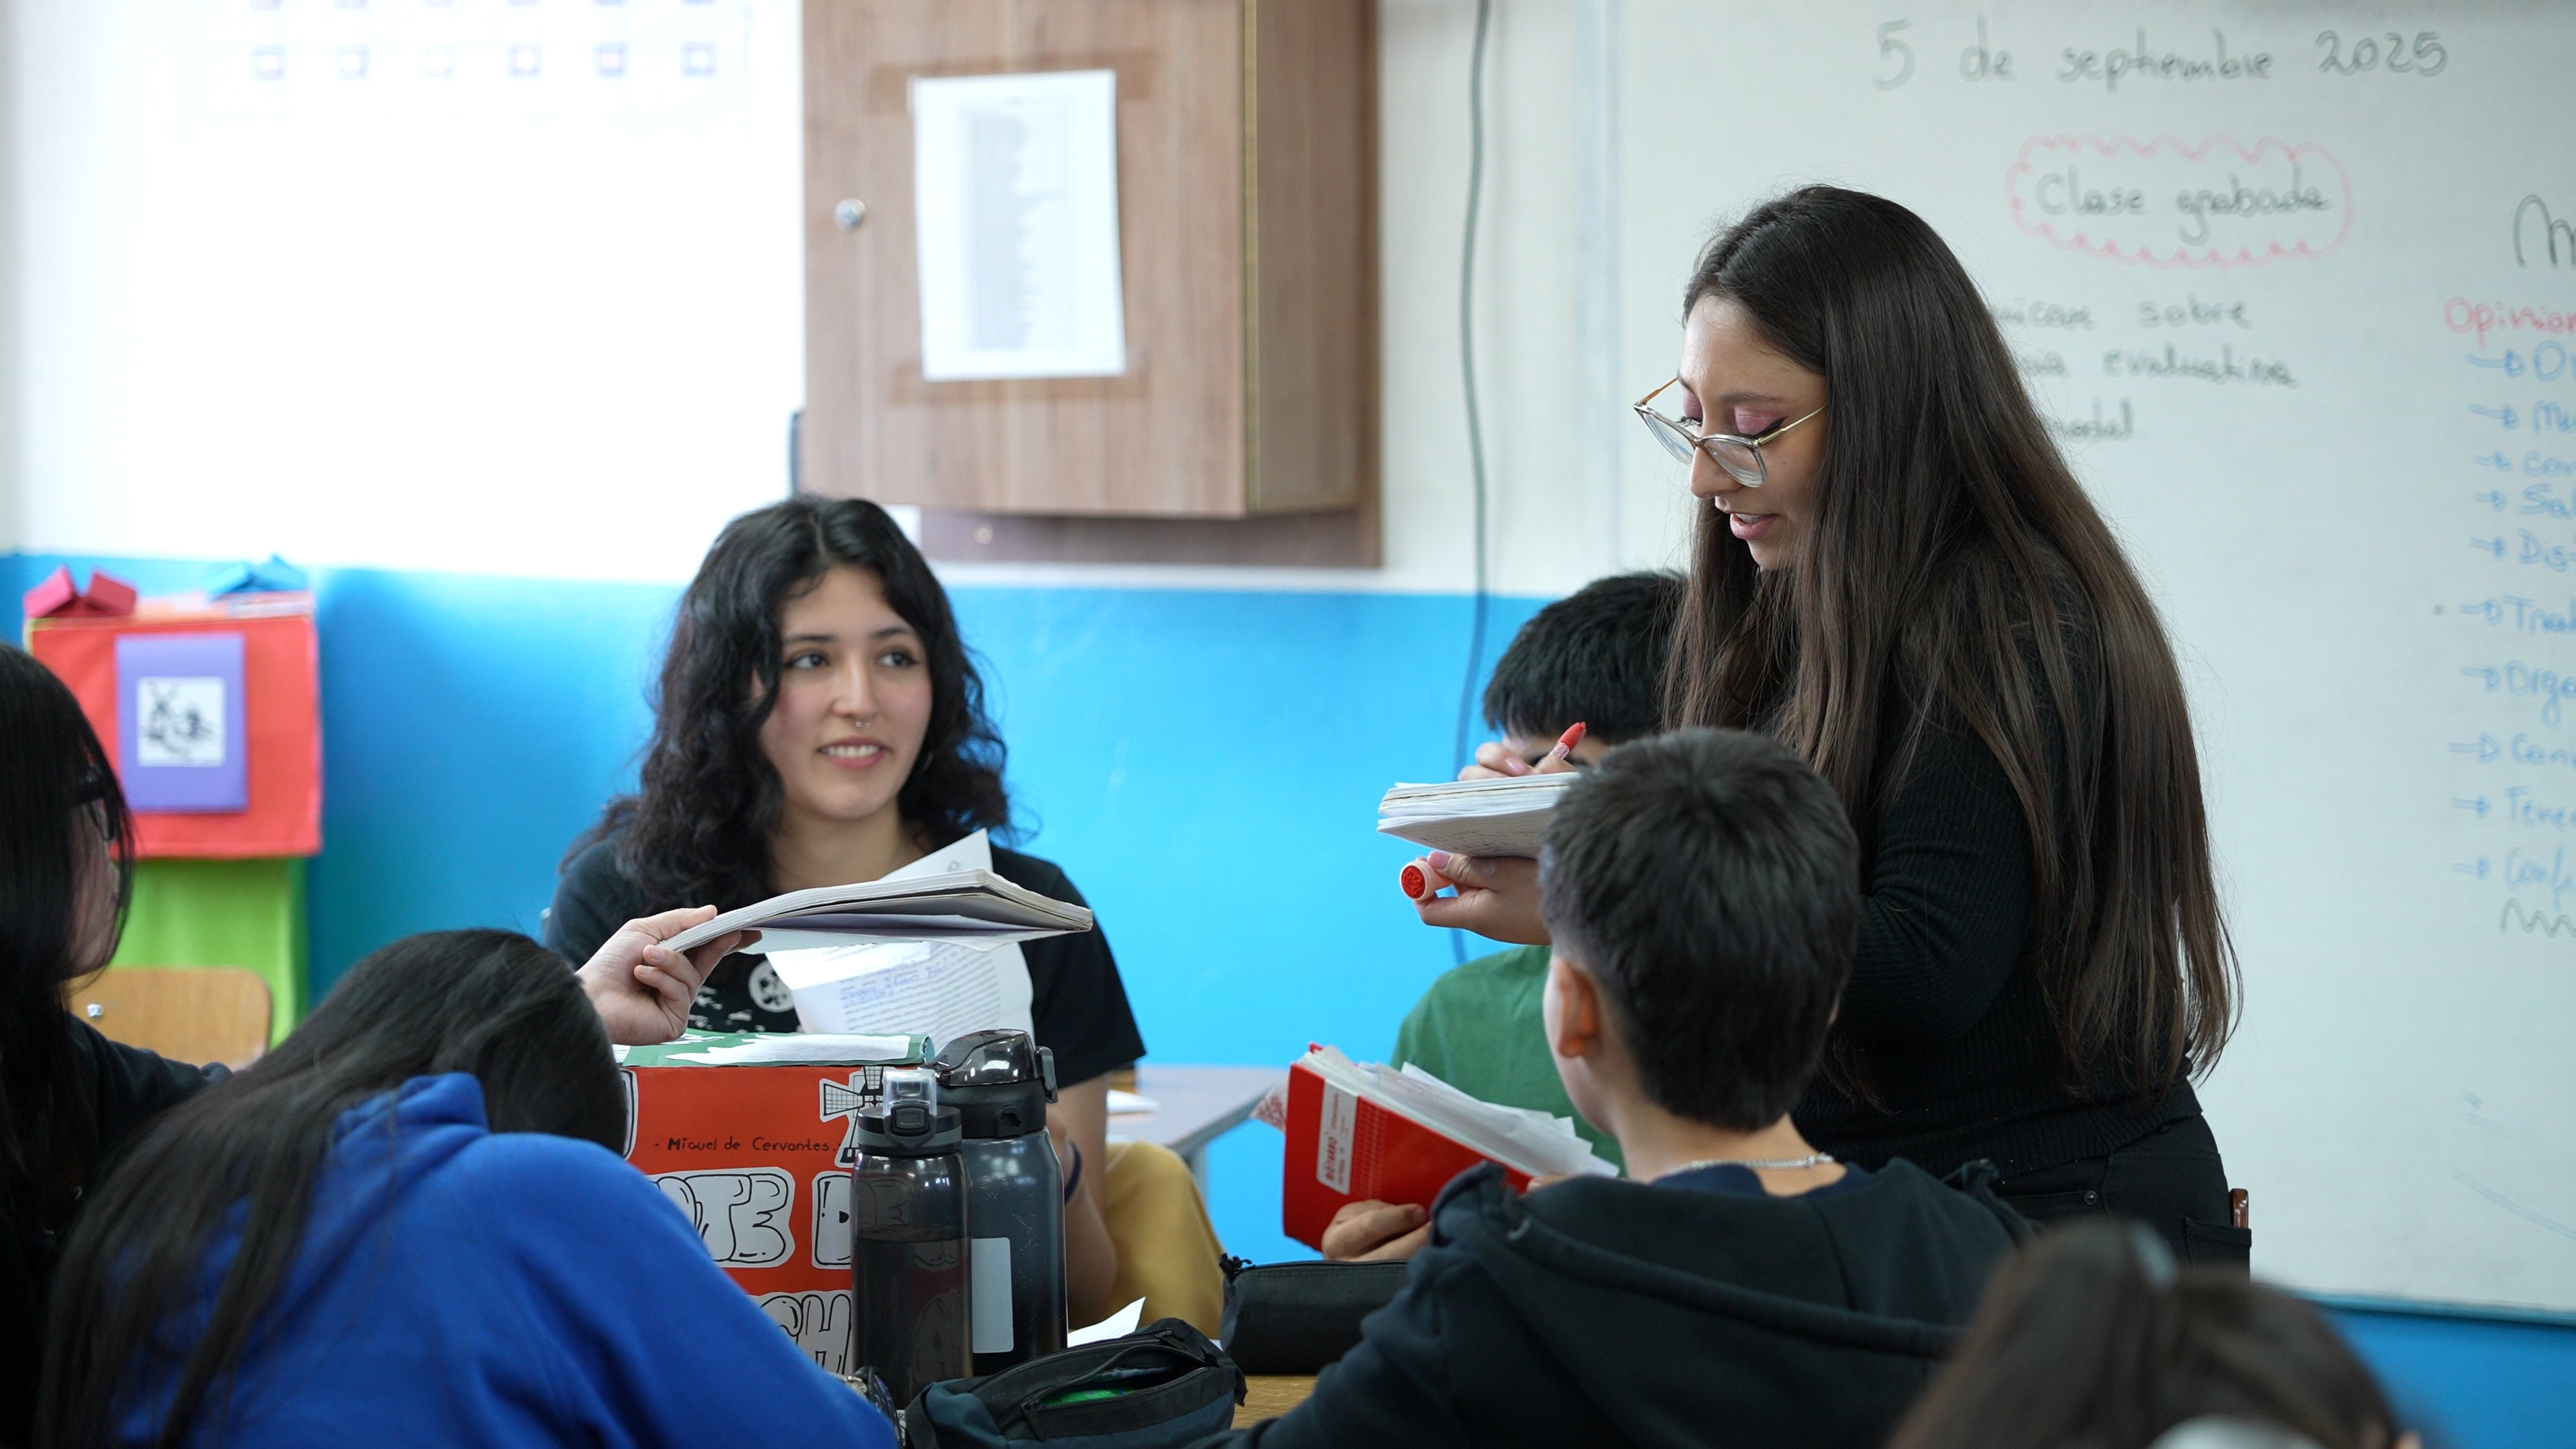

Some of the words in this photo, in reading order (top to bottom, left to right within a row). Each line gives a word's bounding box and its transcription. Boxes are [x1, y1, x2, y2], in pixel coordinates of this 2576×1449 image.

[1871, 17, 1917, 91] 5
[1959, 12, 2015, 81] de
[2054, 25, 2275, 93] septiembre
[2314, 30, 2449, 77] 2025
[2035, 165, 2147, 215] Clase
[2176, 163, 2334, 246] grabada
[2137, 293, 2253, 329] sobre
[724, 1135, 741, 1150] de
